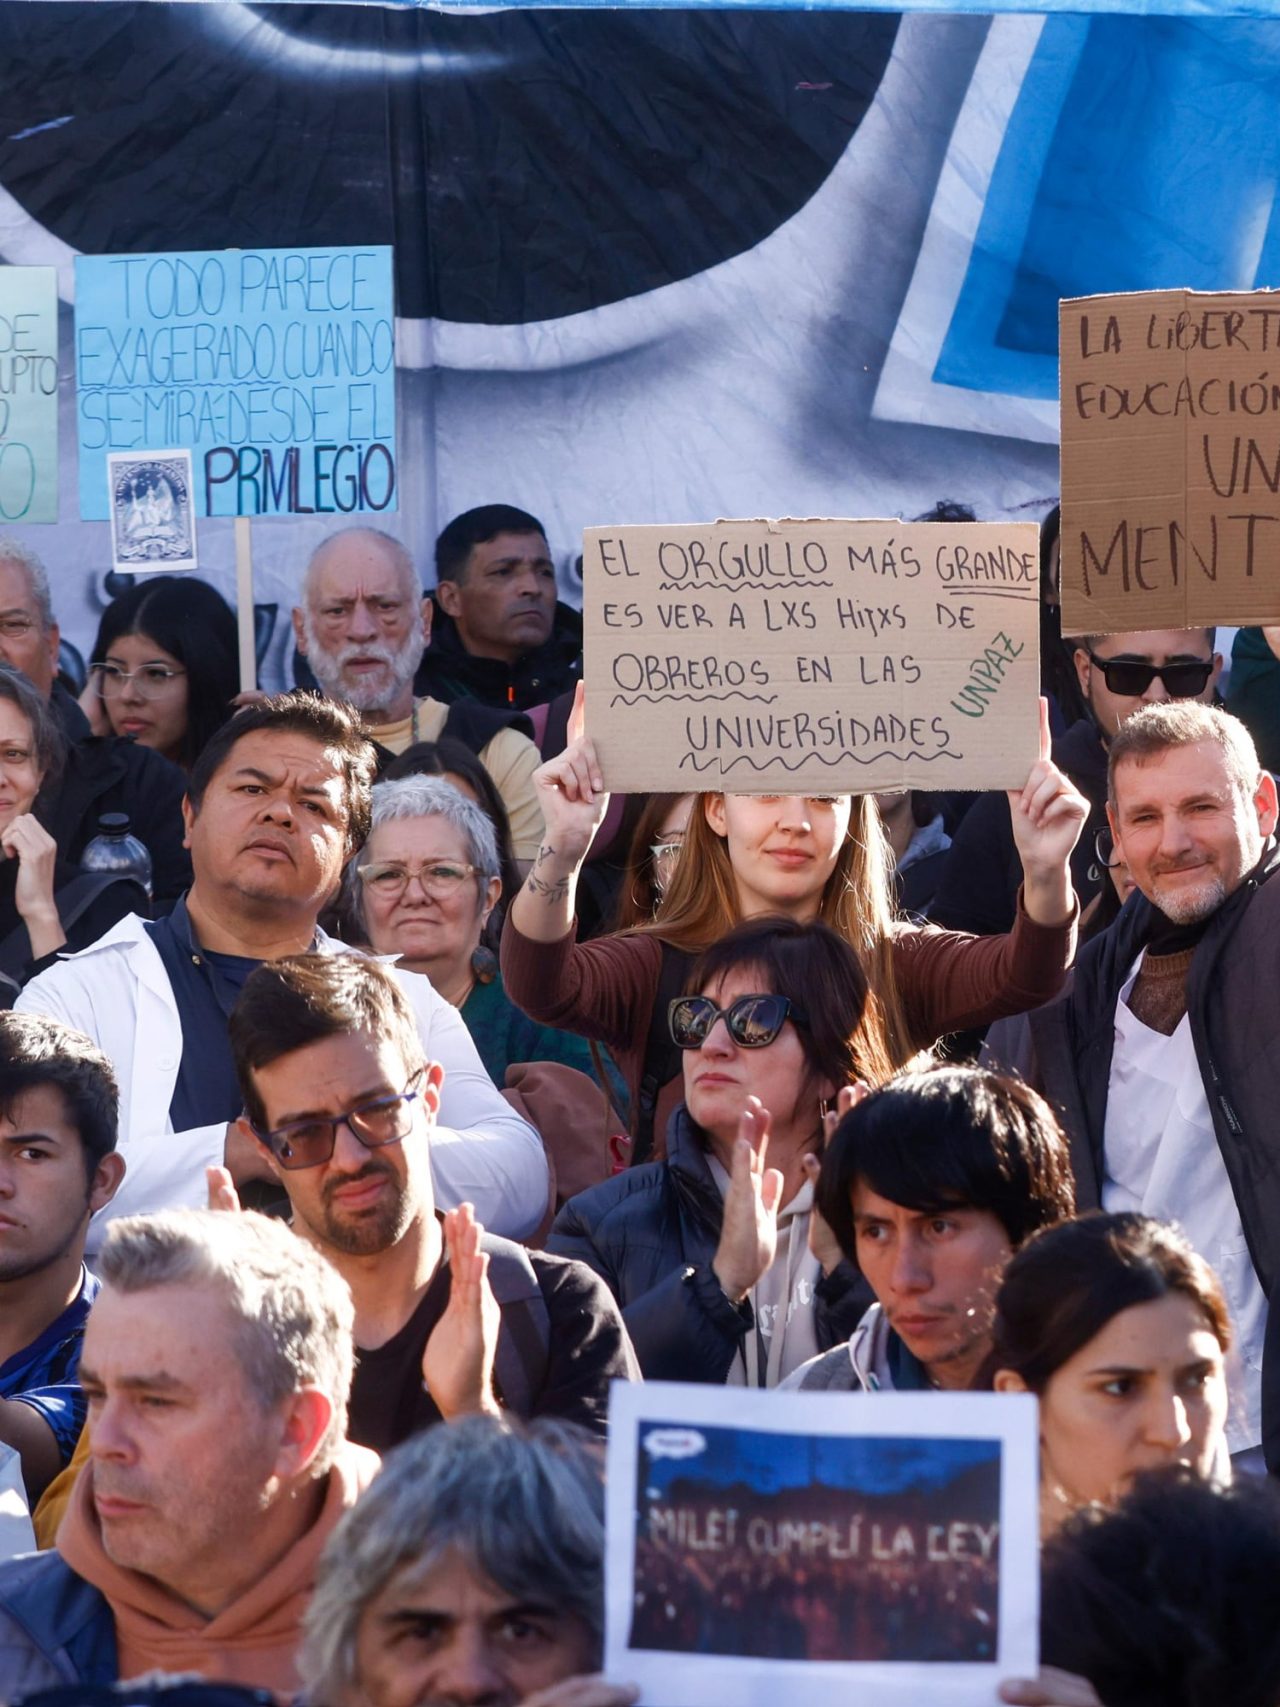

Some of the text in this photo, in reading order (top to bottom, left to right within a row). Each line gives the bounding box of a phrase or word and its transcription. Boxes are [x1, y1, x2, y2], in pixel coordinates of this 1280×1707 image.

[109, 253, 376, 319] TODO PARECE
[79, 319, 394, 386] EXAGERADO CUANDO
[1080, 313, 1122, 360] LA
[80, 391, 133, 450] SE
[228, 384, 336, 445] DESDE
[348, 382, 393, 442] EL
[598, 538, 1039, 583] EL ORGULLO MÁS GRANDE
[604, 603, 643, 628] ES
[657, 603, 714, 630] VER
[728, 603, 746, 629] A
[764, 598, 817, 631] LXS
[936, 603, 976, 629] DE
[612, 653, 921, 692] OBREROS EN LAS
[950, 631, 1025, 718] UNPAZ
[648, 1506, 739, 1551] MILEI
[871, 1522, 916, 1560] LA
[926, 1520, 1000, 1562] LEY
